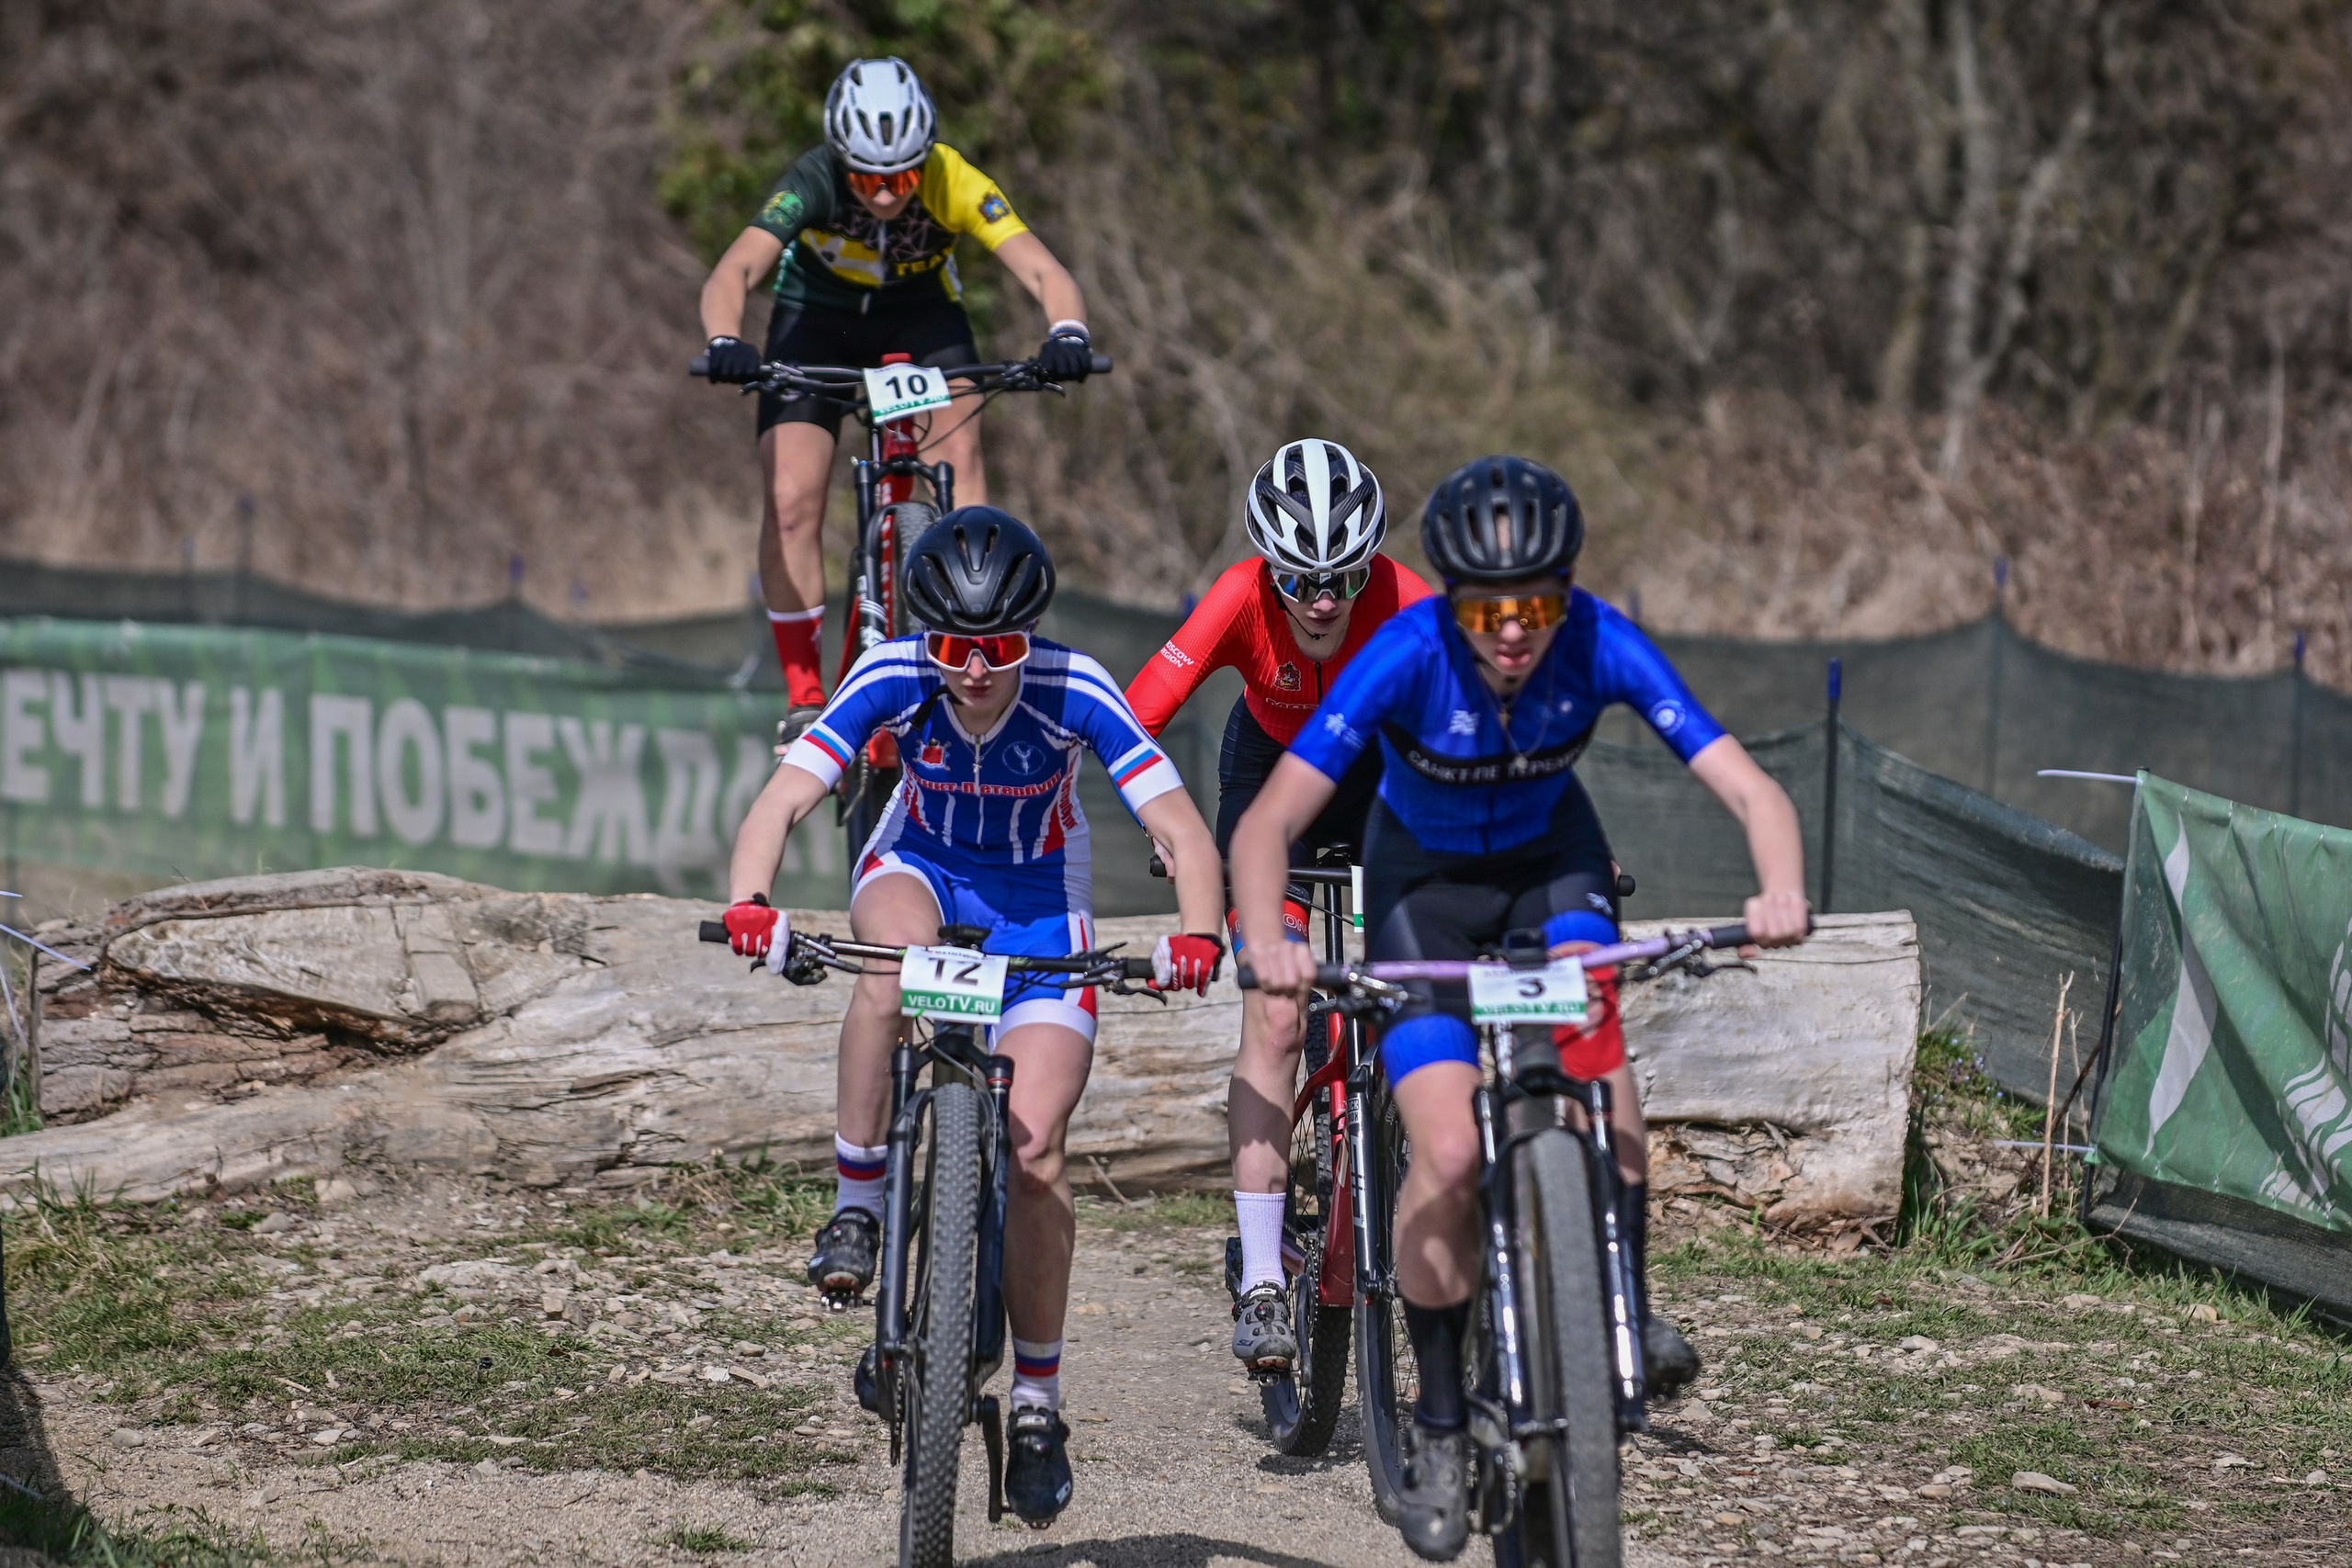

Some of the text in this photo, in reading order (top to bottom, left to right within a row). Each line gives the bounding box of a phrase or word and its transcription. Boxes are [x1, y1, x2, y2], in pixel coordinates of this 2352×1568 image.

[885, 373, 929, 400] 10
[1166, 639, 1194, 665] OSCOW
[2, 669, 206, 818] ЕЧТУ
[231, 682, 285, 826] И
[928, 956, 982, 987] 12
[1516, 976, 1546, 999] 3
